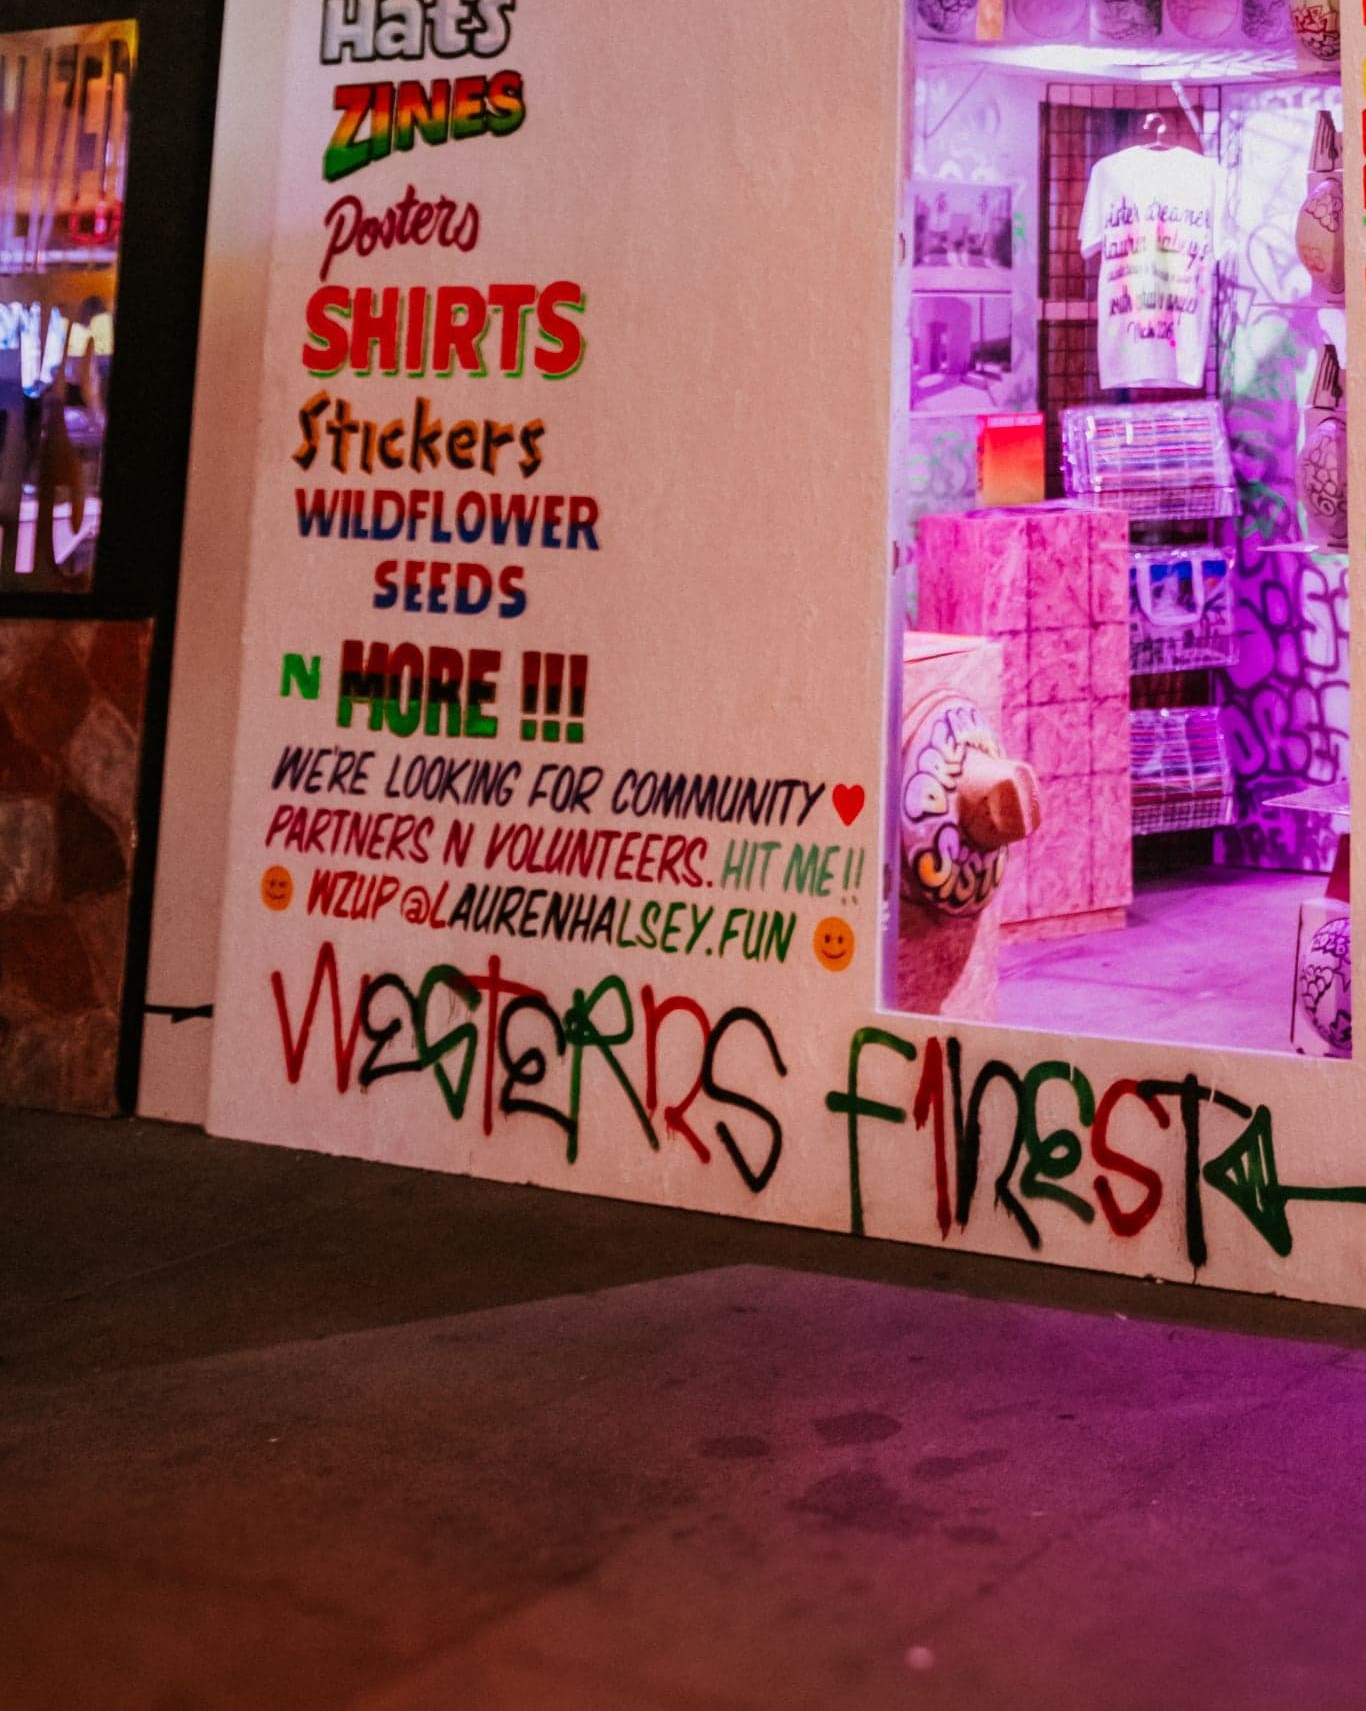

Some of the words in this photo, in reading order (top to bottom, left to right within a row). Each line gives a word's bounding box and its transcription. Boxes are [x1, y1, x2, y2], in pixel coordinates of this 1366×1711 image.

[323, 70, 526, 183] ZINES
[319, 185, 480, 282] Posters
[302, 281, 587, 380] SHIRTS
[292, 389, 546, 478] Stickers
[294, 487, 600, 551] WILDFLOWER
[373, 559, 528, 619] SEEDS
[280, 652, 321, 699] N
[336, 638, 501, 739] MORE
[271, 745, 376, 795] WE'RE
[384, 755, 521, 808] LOOKING
[528, 764, 603, 817] FOR
[611, 767, 826, 827] COMMUNITY
[264, 803, 433, 865] PARTNERS
[443, 822, 476, 869] N
[719, 839, 778, 886] HIT
